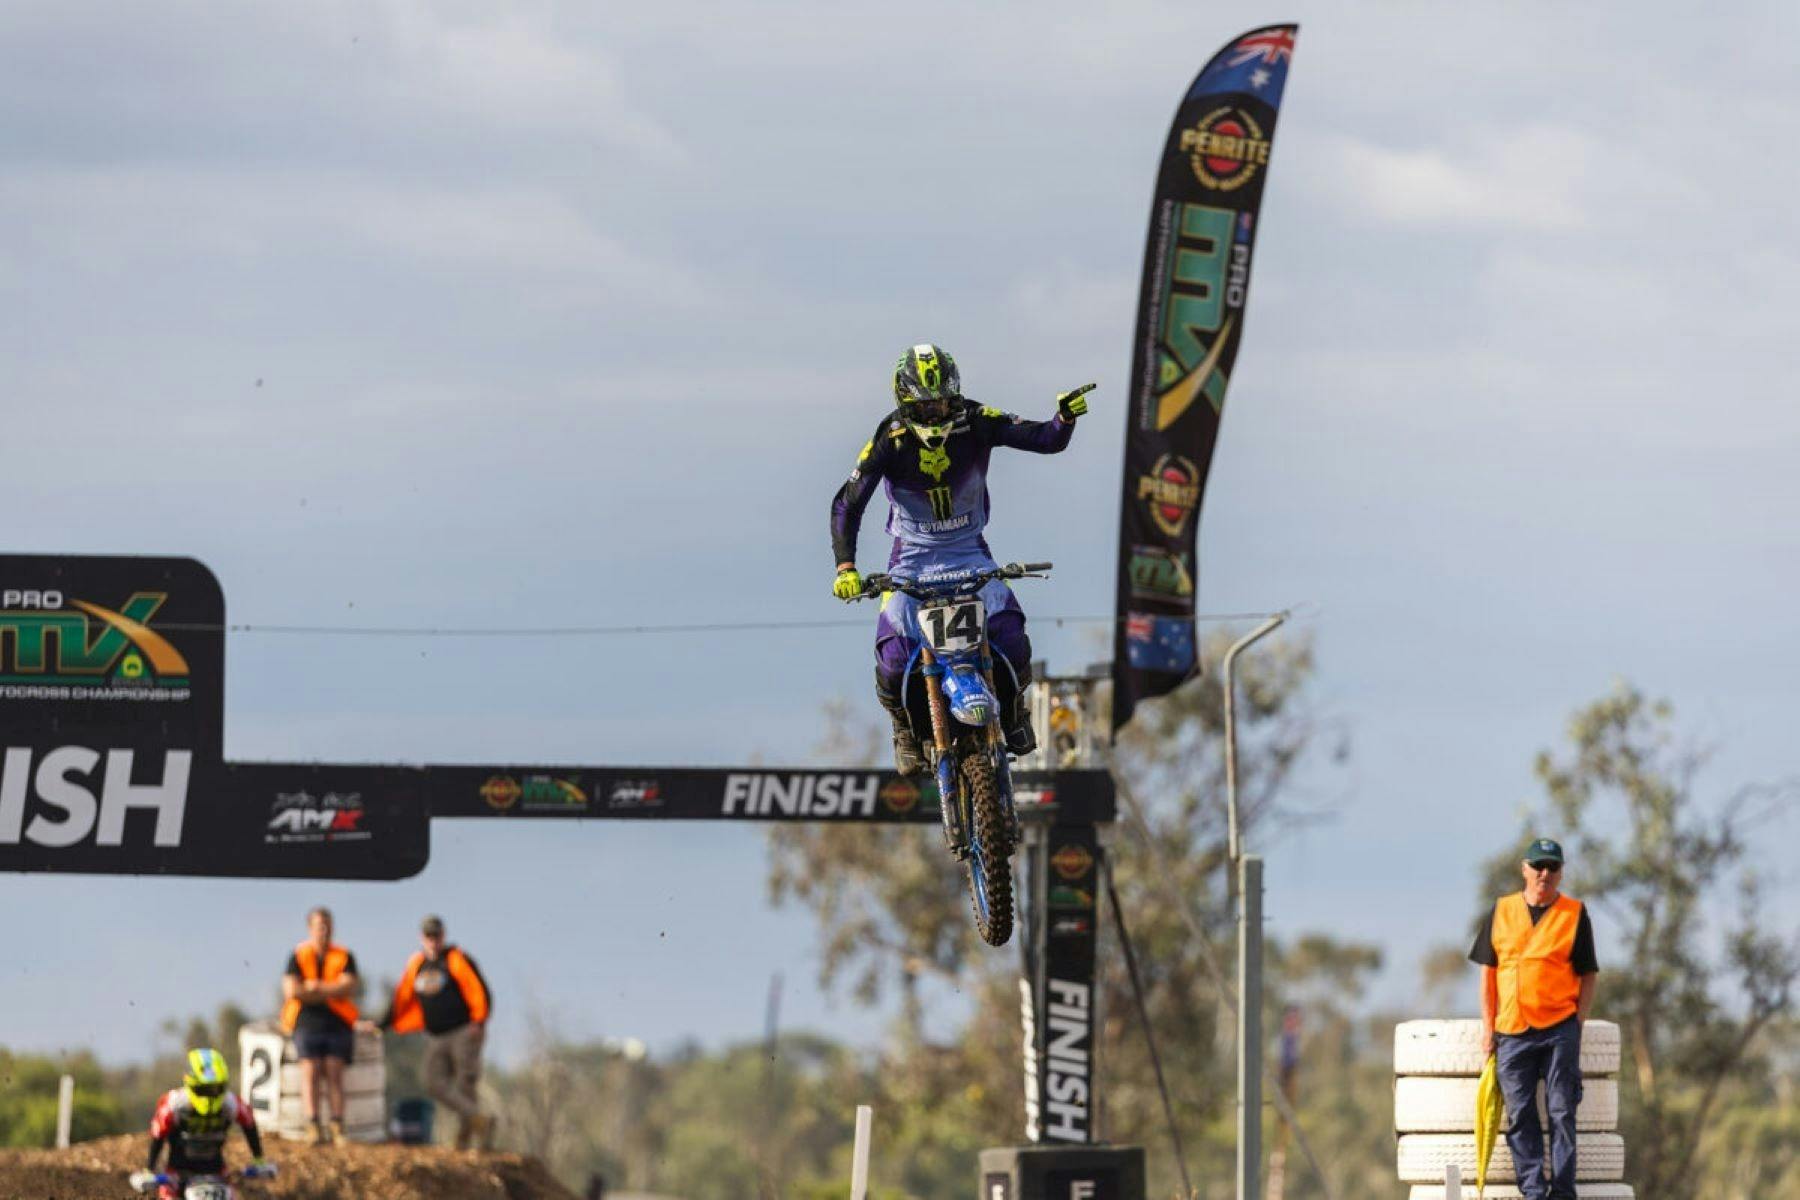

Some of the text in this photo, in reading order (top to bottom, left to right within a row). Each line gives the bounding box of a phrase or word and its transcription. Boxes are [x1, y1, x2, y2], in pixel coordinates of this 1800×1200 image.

[1180, 129, 1271, 165] PENRITE
[1226, 244, 1249, 308] PRO
[931, 514, 969, 533] YAMAHA
[3, 589, 63, 609] PRO
[927, 604, 982, 647] 14
[721, 774, 879, 815] FINISH
[250, 1048, 272, 1112] 2
[1047, 978, 1090, 1142] FINISH
